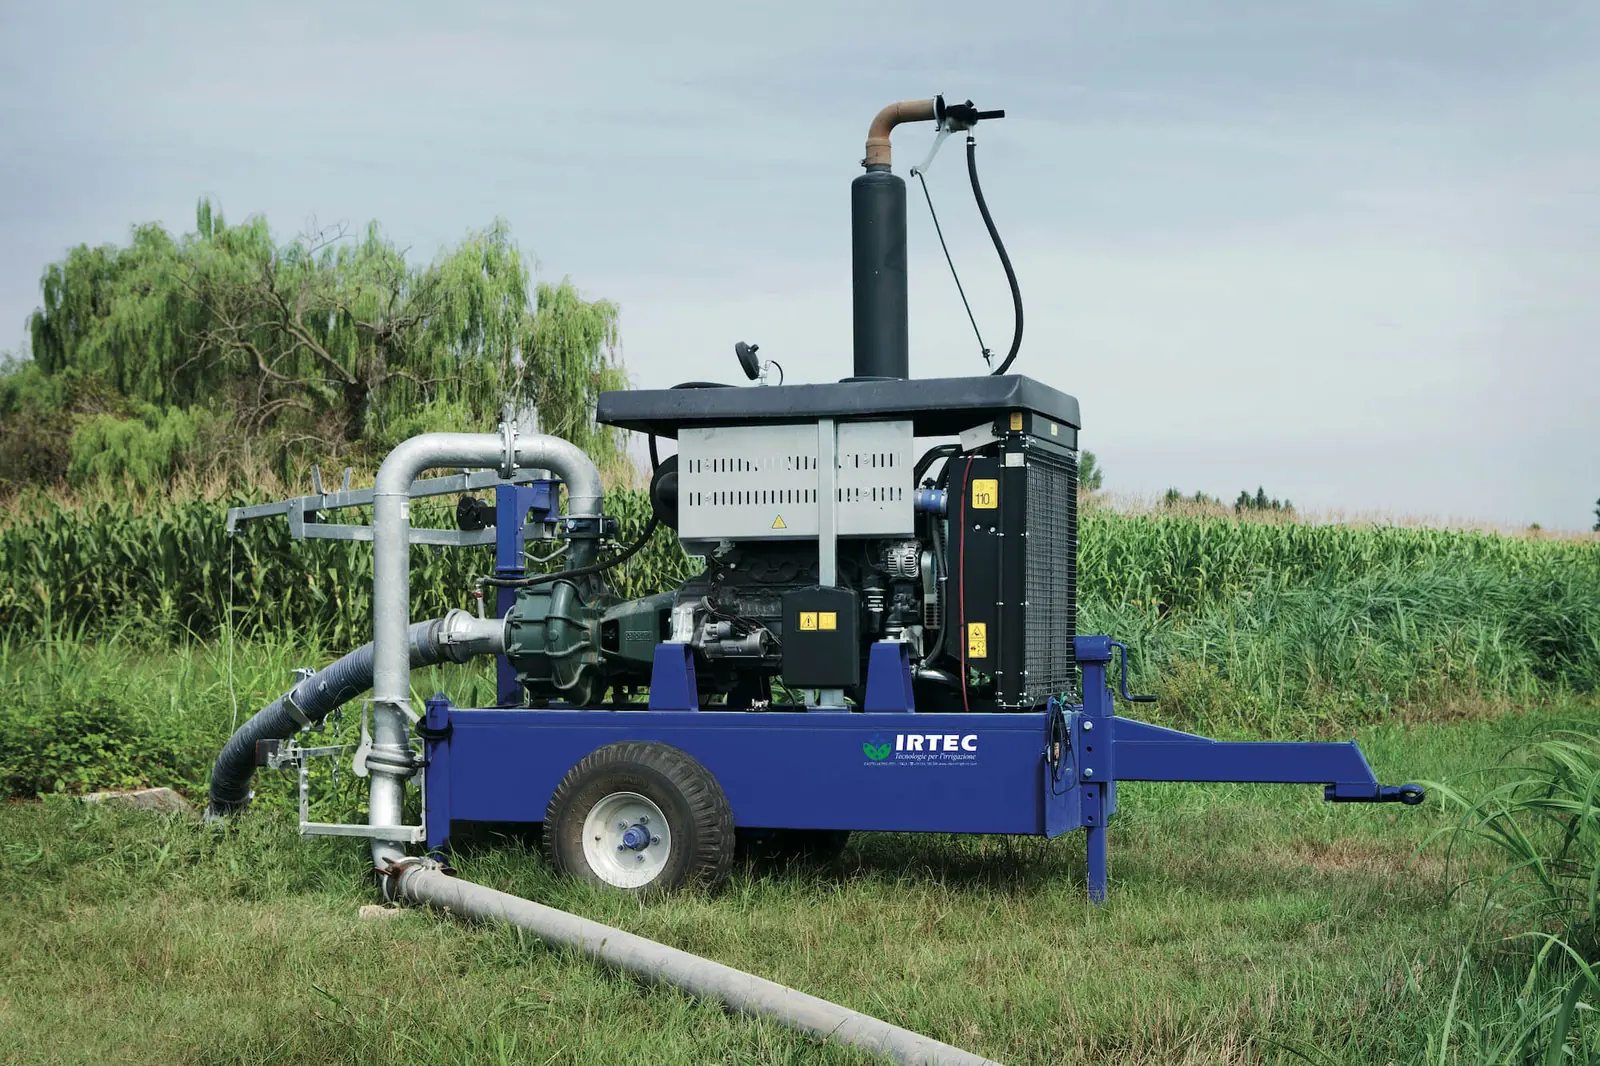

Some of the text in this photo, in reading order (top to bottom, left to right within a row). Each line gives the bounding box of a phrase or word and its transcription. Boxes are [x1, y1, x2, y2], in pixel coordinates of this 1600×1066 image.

[975, 492, 990, 505] 110
[895, 734, 978, 752] IRTEC
[895, 752, 927, 761] Tecnologie
[927, 753, 939, 761] per
